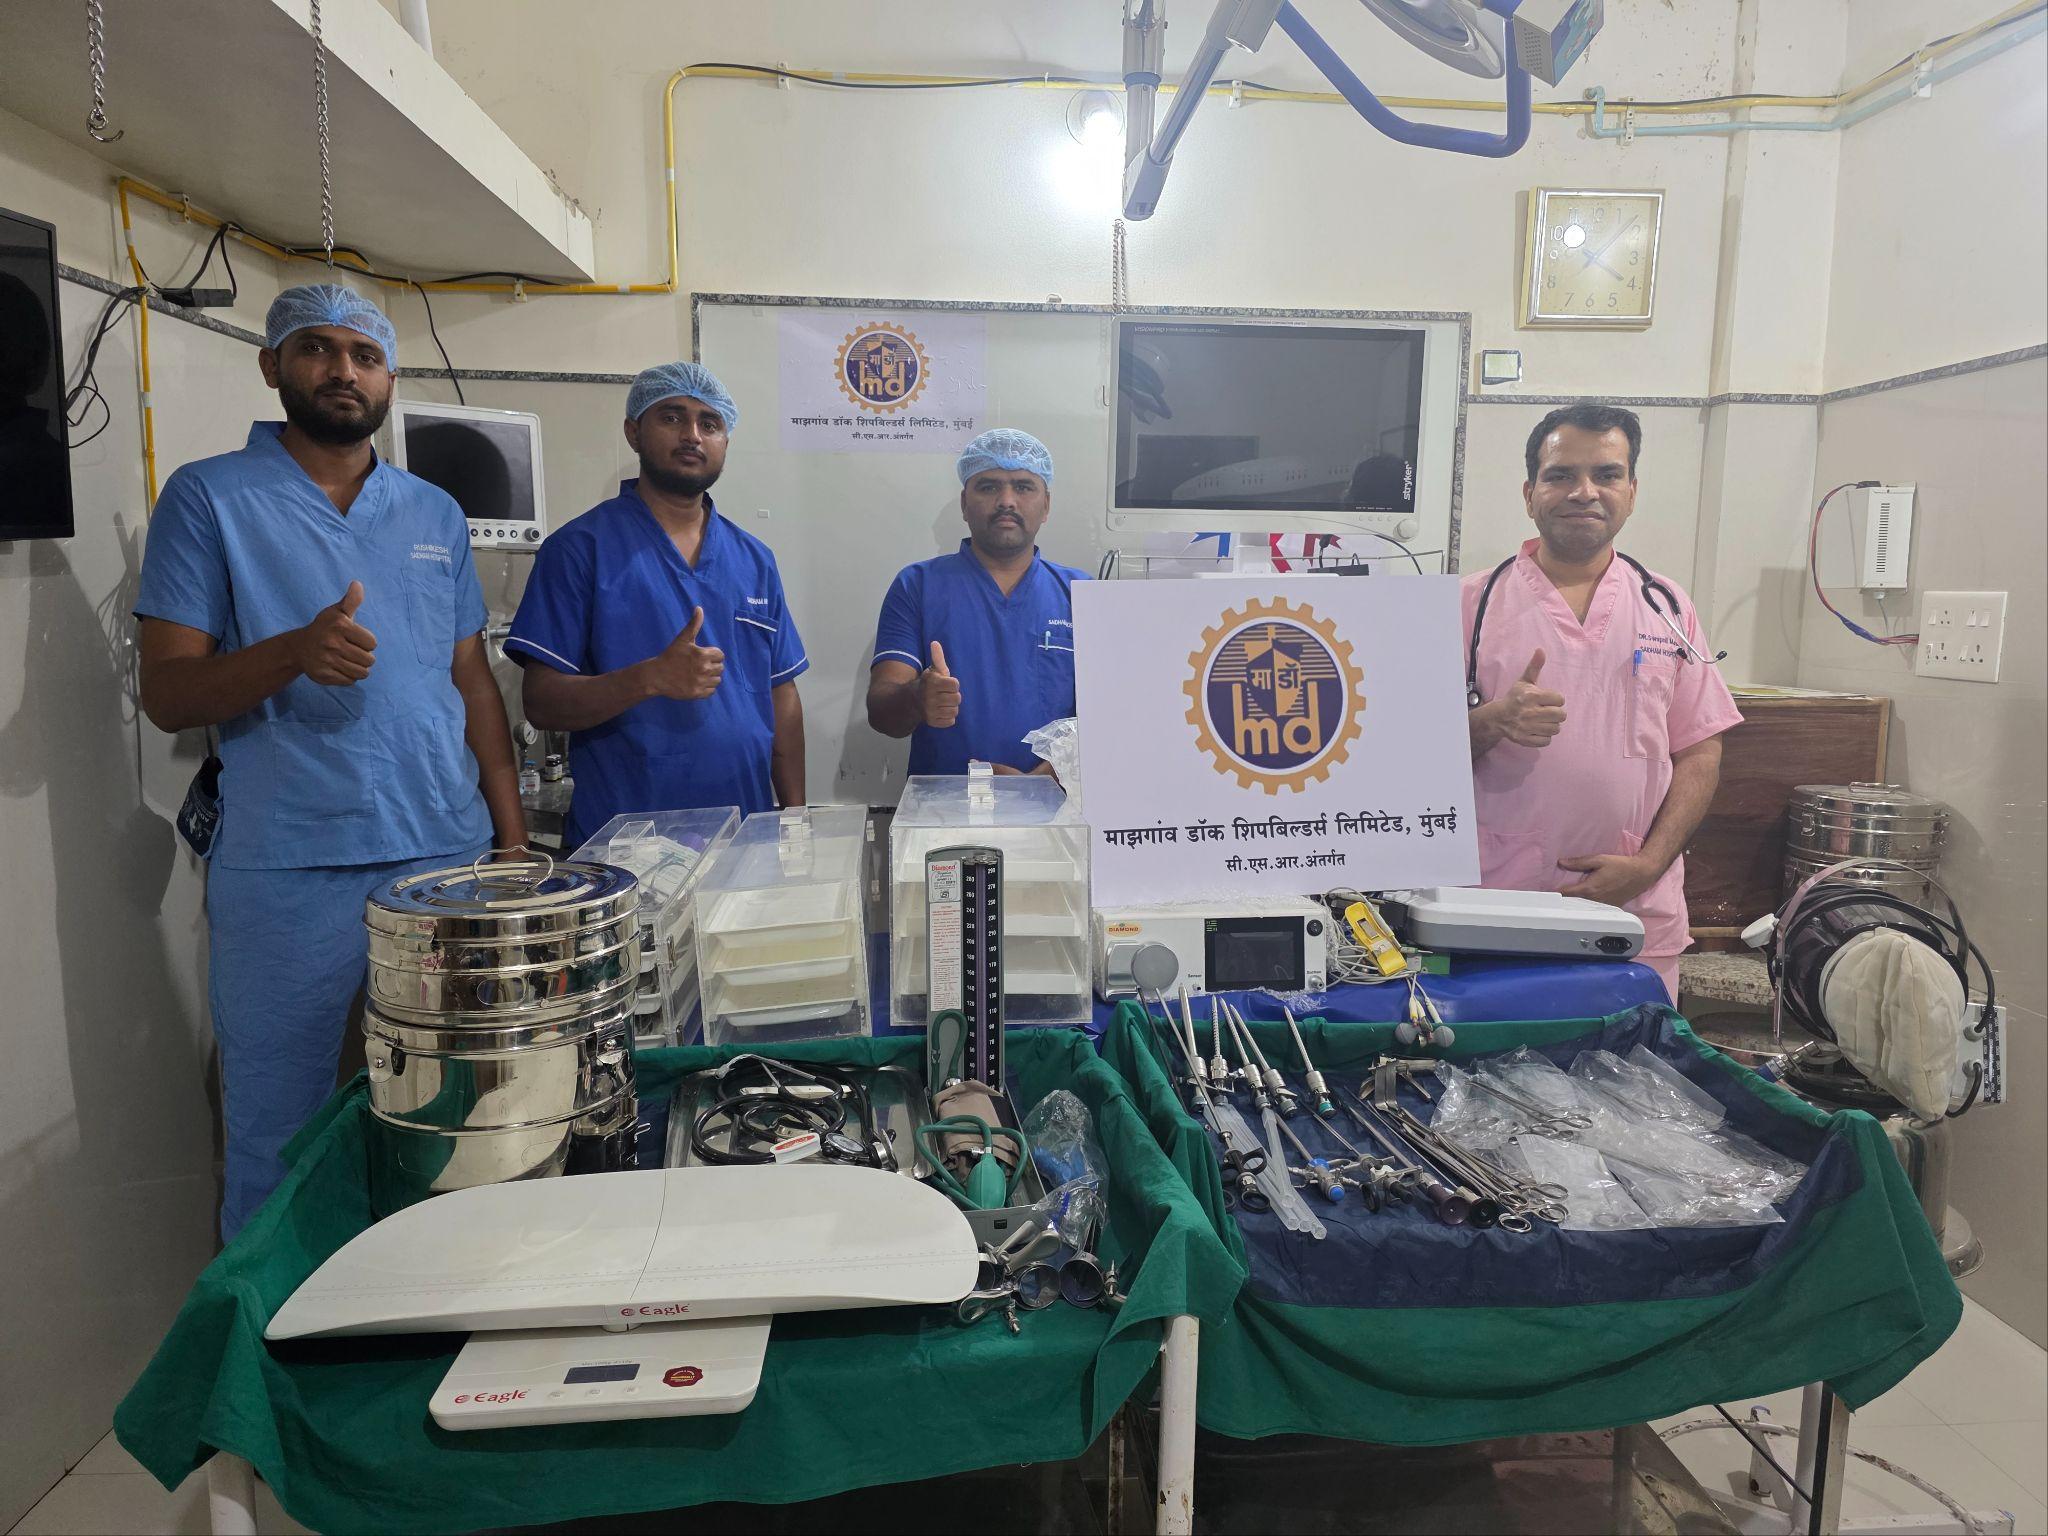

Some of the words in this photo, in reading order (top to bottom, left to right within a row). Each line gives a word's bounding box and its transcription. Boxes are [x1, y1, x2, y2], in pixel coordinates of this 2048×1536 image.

[1551, 225, 1563, 241] 10
[1629, 251, 1639, 266] 3
[1547, 274, 1556, 289] 8
[1627, 276, 1637, 291] 4
[1565, 293, 1575, 307] 7
[1585, 293, 1595, 307] 6
[1608, 293, 1617, 307] 5
[859, 360, 905, 396] md
[790, 415, 829, 426] माझगांव
[832, 414, 853, 427] डॉक
[856, 415, 906, 428] शिपबिल्डर्स
[953, 416, 976, 430] मुंबई
[1402, 463, 1413, 501] stryker
[1231, 680, 1322, 755] md
[1103, 819, 1178, 849] माझगांव
[1185, 817, 1225, 843] डॉक
[1231, 812, 1328, 842] शिपबिल्डर्स
[1334, 809, 1412, 836] लिमिटेड,
[1418, 806, 1458, 838] मुंबई
[931, 864, 956, 872] Diamond
[640, 1303, 690, 1316] Eagle
[474, 1389, 529, 1404] Eagle
